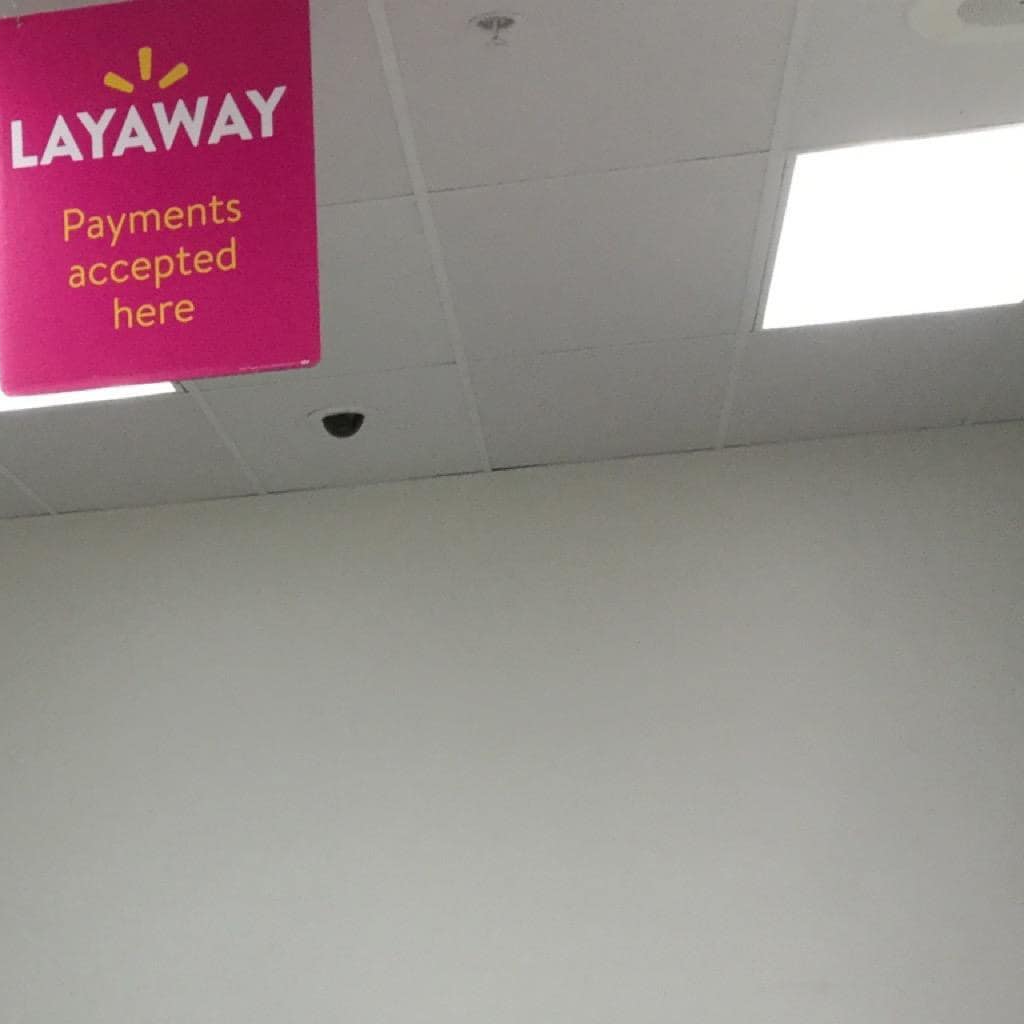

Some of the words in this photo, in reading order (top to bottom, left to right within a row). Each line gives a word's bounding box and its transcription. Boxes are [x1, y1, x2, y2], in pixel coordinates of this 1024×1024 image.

[10, 85, 287, 169] LAYAWAY
[63, 195, 243, 247] Payments
[68, 236, 237, 289] accepted
[113, 297, 195, 330] here
